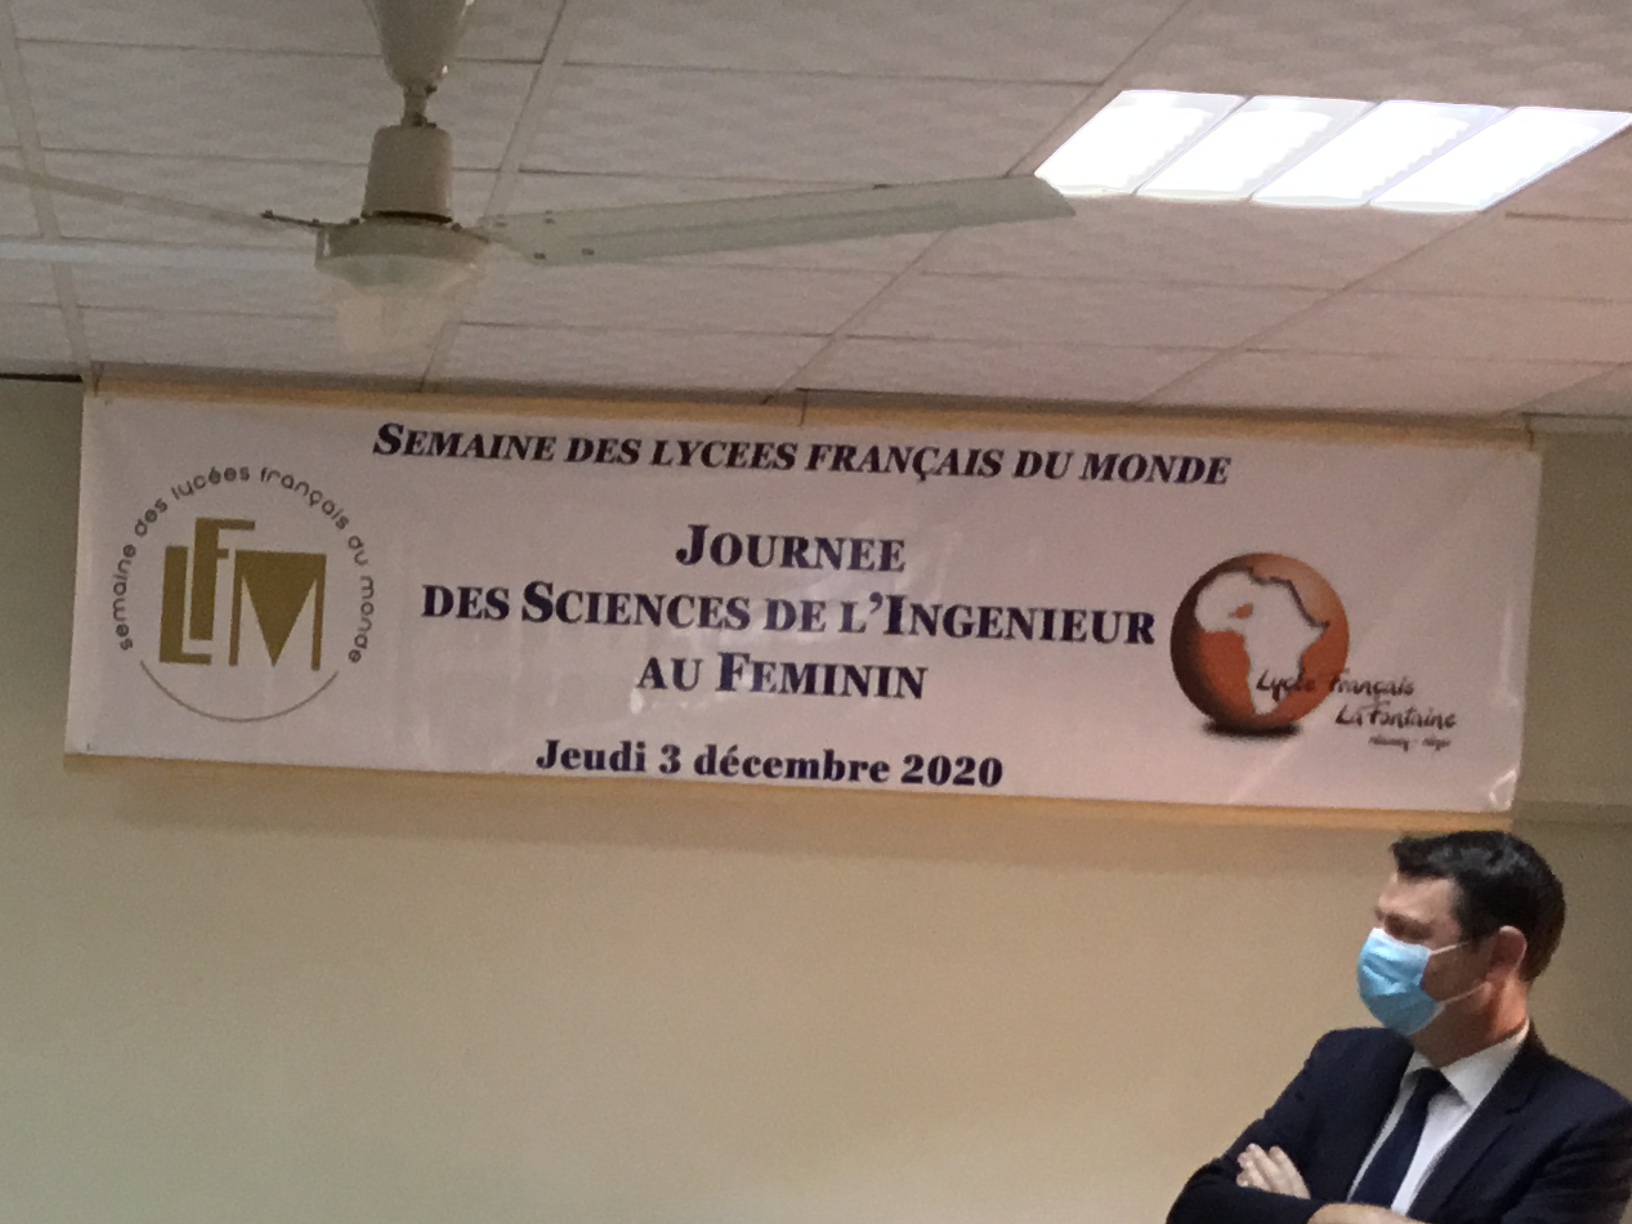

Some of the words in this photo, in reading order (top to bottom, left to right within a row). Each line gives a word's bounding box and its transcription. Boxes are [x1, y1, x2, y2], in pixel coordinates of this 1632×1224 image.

[372, 421, 557, 461] SEMAINE
[563, 436, 643, 466] DES
[651, 439, 798, 471] LYCEES
[805, 443, 1004, 483] FRANÇAIS
[1012, 449, 1072, 480] DU
[1079, 452, 1233, 485] MONDE
[170, 466, 251, 501] lycées
[260, 466, 350, 531] français
[134, 497, 169, 538] des
[347, 534, 369, 567] du
[675, 524, 907, 573] JOURNEE
[111, 543, 137, 651] semaine
[159, 516, 328, 671] LFM
[347, 574, 375, 664] monde
[421, 584, 511, 621] DES
[521, 580, 752, 631] SCIENCES
[763, 597, 827, 633] DE
[837, 591, 1157, 646] L'INGENIEUR
[636, 656, 704, 692] AU
[715, 651, 929, 700] FEMININ
[536, 738, 647, 773] Jeudi
[658, 744, 682, 775] 3
[693, 743, 891, 784] décembre
[900, 753, 1004, 788] 2020
